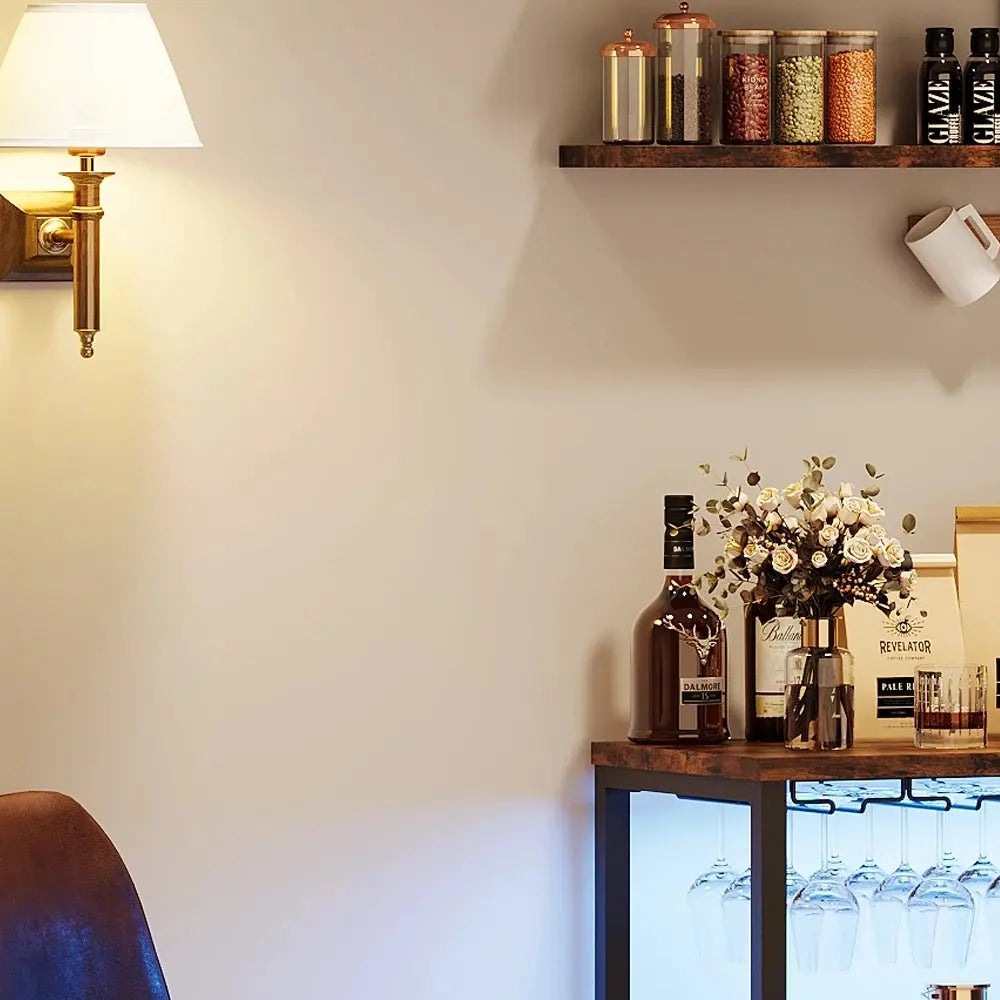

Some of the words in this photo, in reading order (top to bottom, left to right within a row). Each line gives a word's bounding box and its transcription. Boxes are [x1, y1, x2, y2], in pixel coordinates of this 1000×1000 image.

[927, 80, 950, 144] GLAZE
[973, 80, 995, 144] GLAZE
[761, 619, 802, 642] Ballan
[879, 640, 932, 655] REVELATOR
[684, 682, 721, 691] DALMORE
[881, 682, 904, 692] PALE
